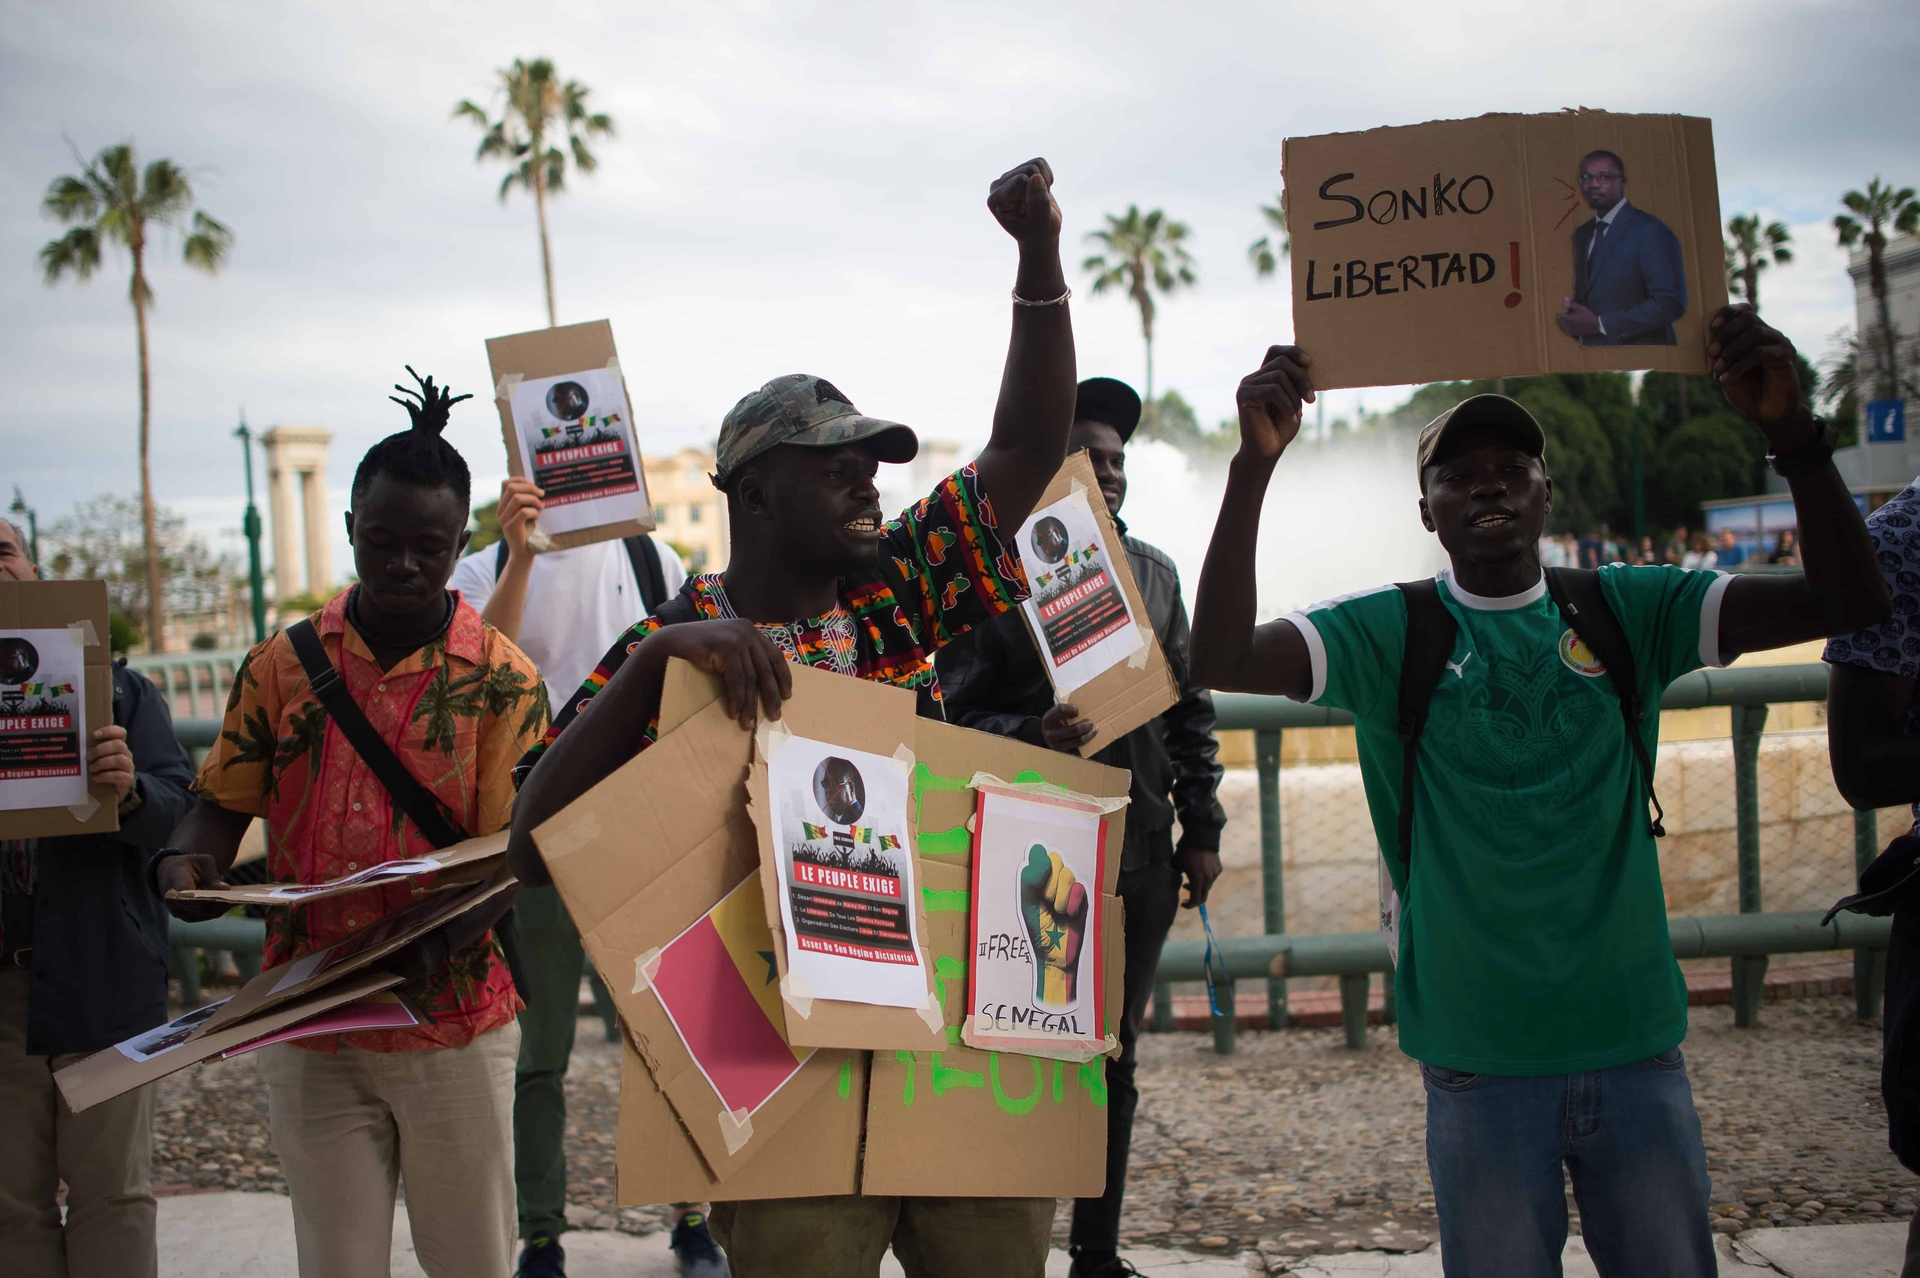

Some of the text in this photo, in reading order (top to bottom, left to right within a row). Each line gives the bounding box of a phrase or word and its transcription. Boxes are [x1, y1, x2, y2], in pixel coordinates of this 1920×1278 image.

[1314, 172, 1494, 231] SONKO
[542, 442, 619, 465] LE PEUPLE EXIGE
[1045, 605, 1056, 617] LE
[1055, 588, 1083, 611] PEUPLE
[1083, 575, 1105, 595] EXIGE
[31, 717, 65, 729] EXIGE
[801, 865, 895, 895] LE PEUPLE EXIGE
[802, 937, 822, 951] Assez
[823, 940, 833, 952] De
[833, 942, 848, 954] Son
[875, 949, 915, 963] Dictatorial
[980, 1003, 1086, 1035] SENEGAL
